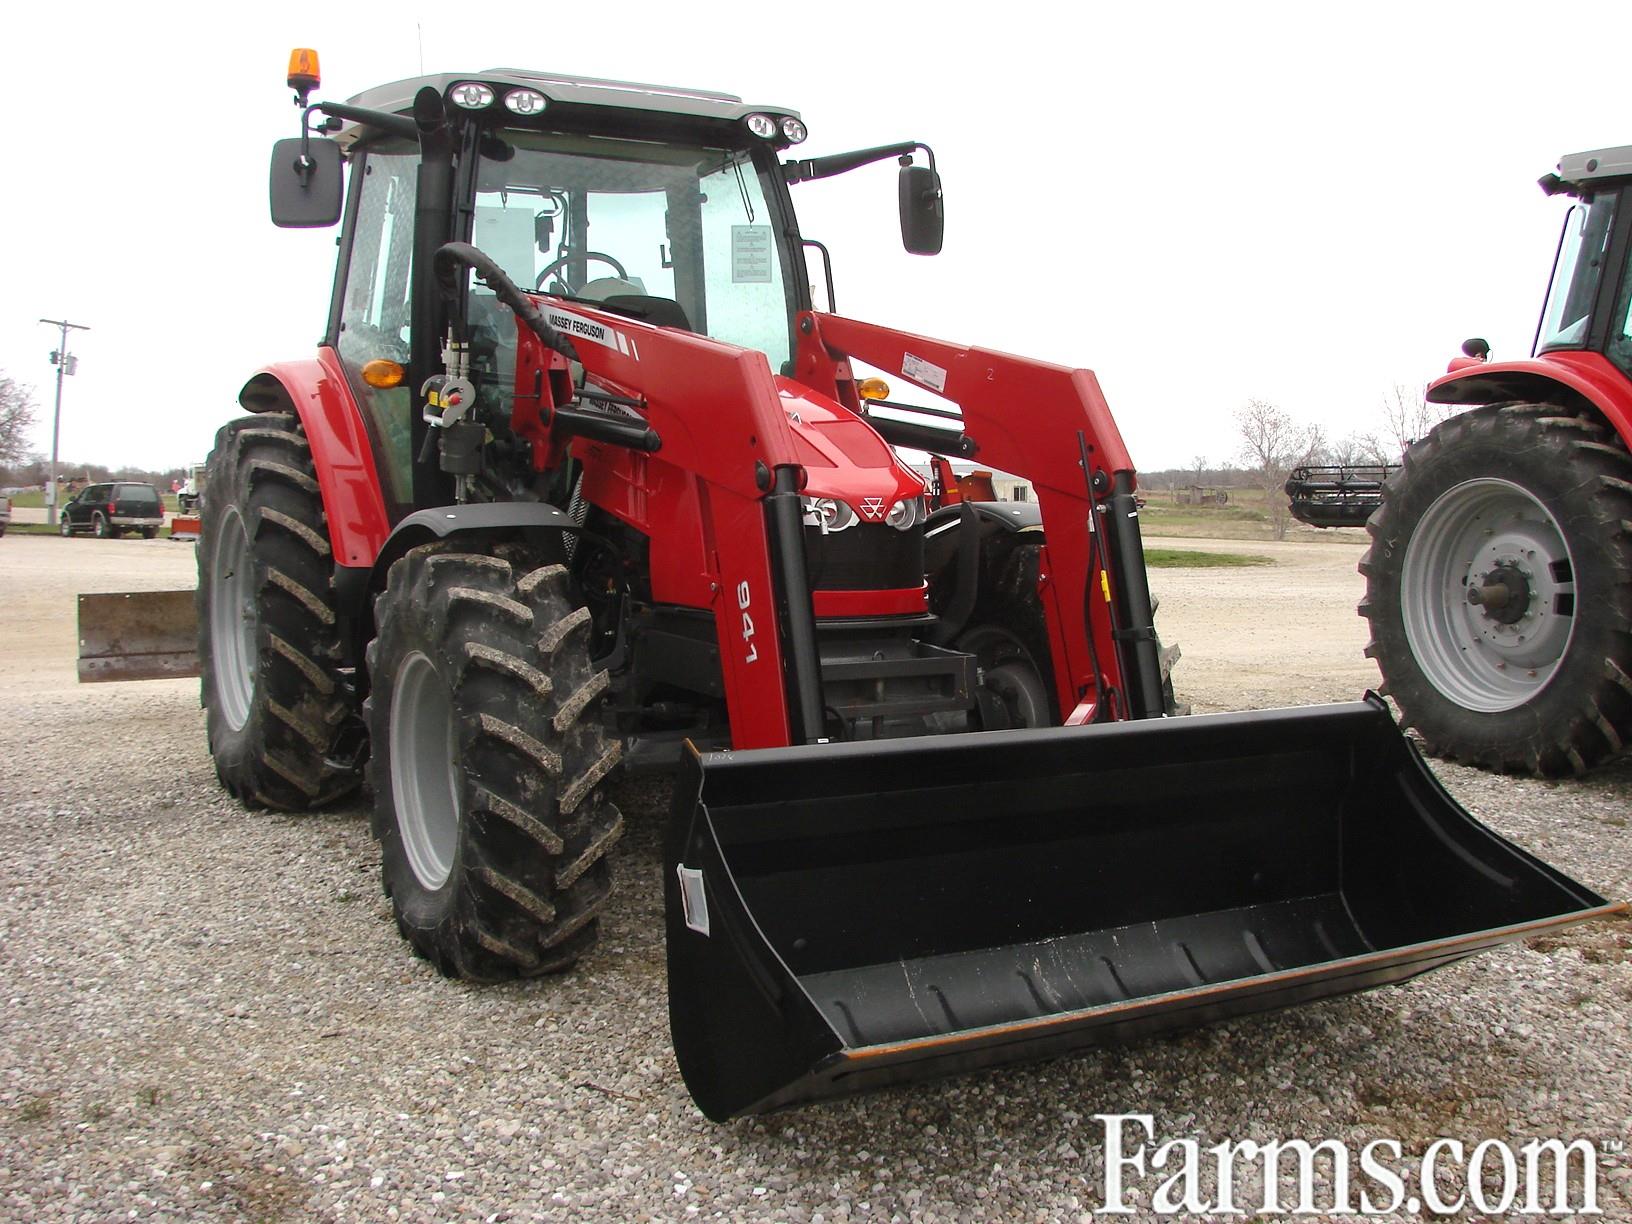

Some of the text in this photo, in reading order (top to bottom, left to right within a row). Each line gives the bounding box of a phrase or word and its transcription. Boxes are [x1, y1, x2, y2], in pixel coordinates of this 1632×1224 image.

[549, 313, 605, 340] MASSEY FERGUSON
[986, 367, 994, 381] 2
[737, 580, 758, 664] 941
